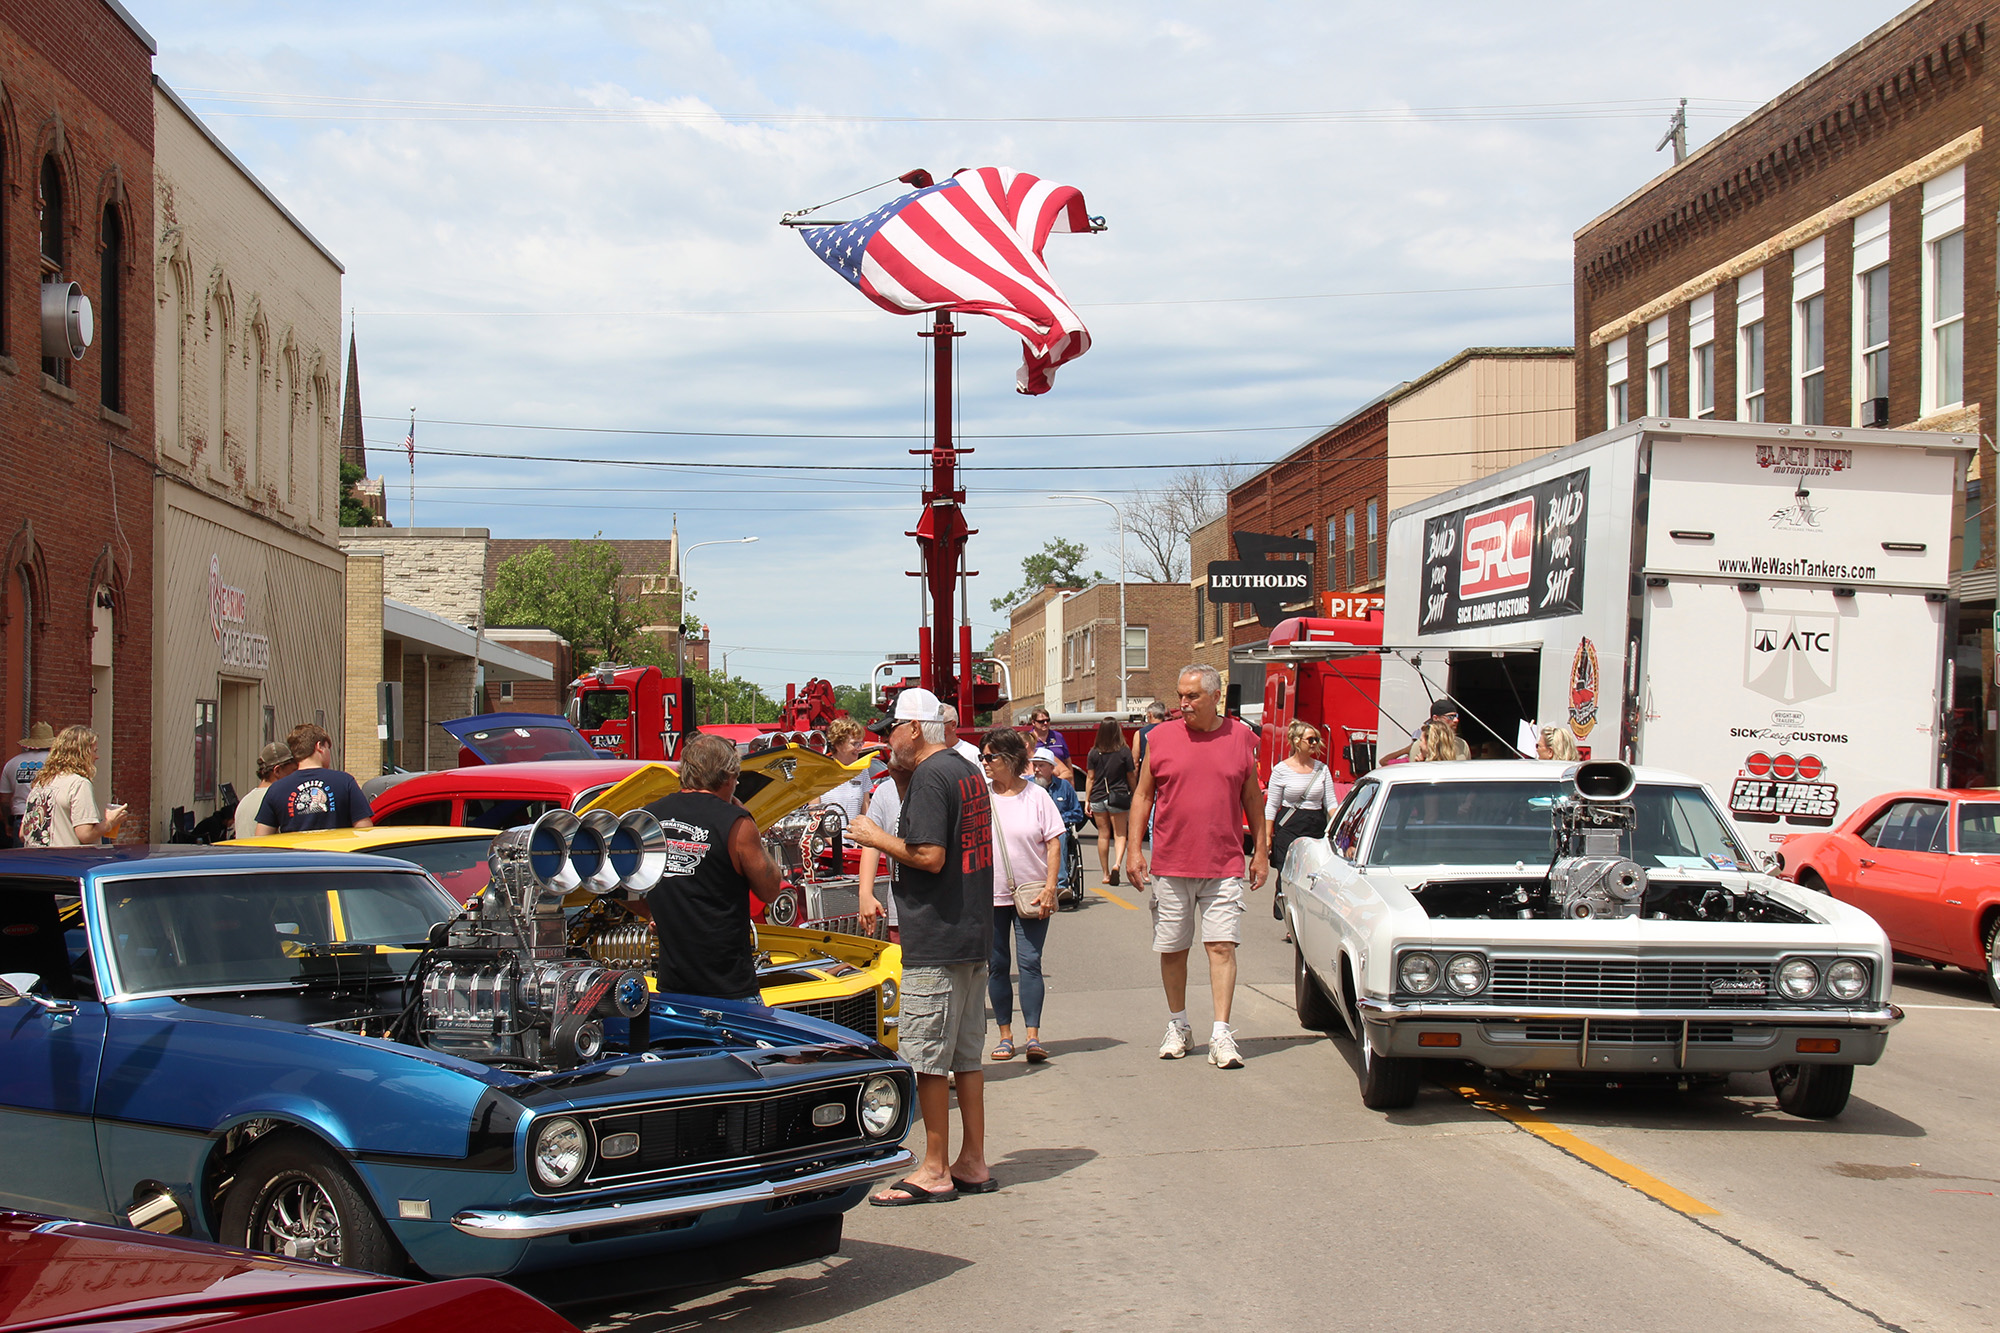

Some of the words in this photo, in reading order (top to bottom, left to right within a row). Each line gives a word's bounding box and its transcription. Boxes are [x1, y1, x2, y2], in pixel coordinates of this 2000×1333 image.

[1756, 445, 1810, 468] BLACK
[1814, 448, 1853, 471] IRON
[1773, 467, 1831, 476] MOTORSPORTS
[1543, 482, 1583, 535] BUILD
[1426, 521, 1455, 564] BUILD
[1461, 512, 1530, 585] SRC
[1550, 536, 1572, 564] YOUR
[1430, 565, 1447, 589] YOUR
[1718, 556, 1875, 579] www.WeWashTankers.com
[1211, 574, 1307, 588] LEUTHOLDS
[1540, 557, 1575, 608] SHIT
[1423, 584, 1448, 625] SHIT
[1457, 606, 1472, 624] SICK
[1472, 602, 1497, 621] RACING
[1497, 596, 1530, 618] CUSTOMS
[222, 628, 240, 665] CARE
[240, 632, 269, 670] CENTERS
[1782, 631, 1830, 652] ATC
[1730, 728, 1757, 738] SICK
[1792, 732, 1848, 743] CUSTOMS
[297, 780, 324, 791] WHITE
[1734, 780, 1773, 797] FAT
[1776, 783, 1836, 801] TIRES
[1736, 797, 1837, 816] BLOWERS
[667, 840, 709, 854] TREET
[801, 834, 816, 882] LOWN
[1753, 850, 1766, 859] TC
[1710, 978, 1766, 989] Chevrolet
[248, 1186, 267, 1227] WELD
[278, 1169, 320, 1185] RACING
